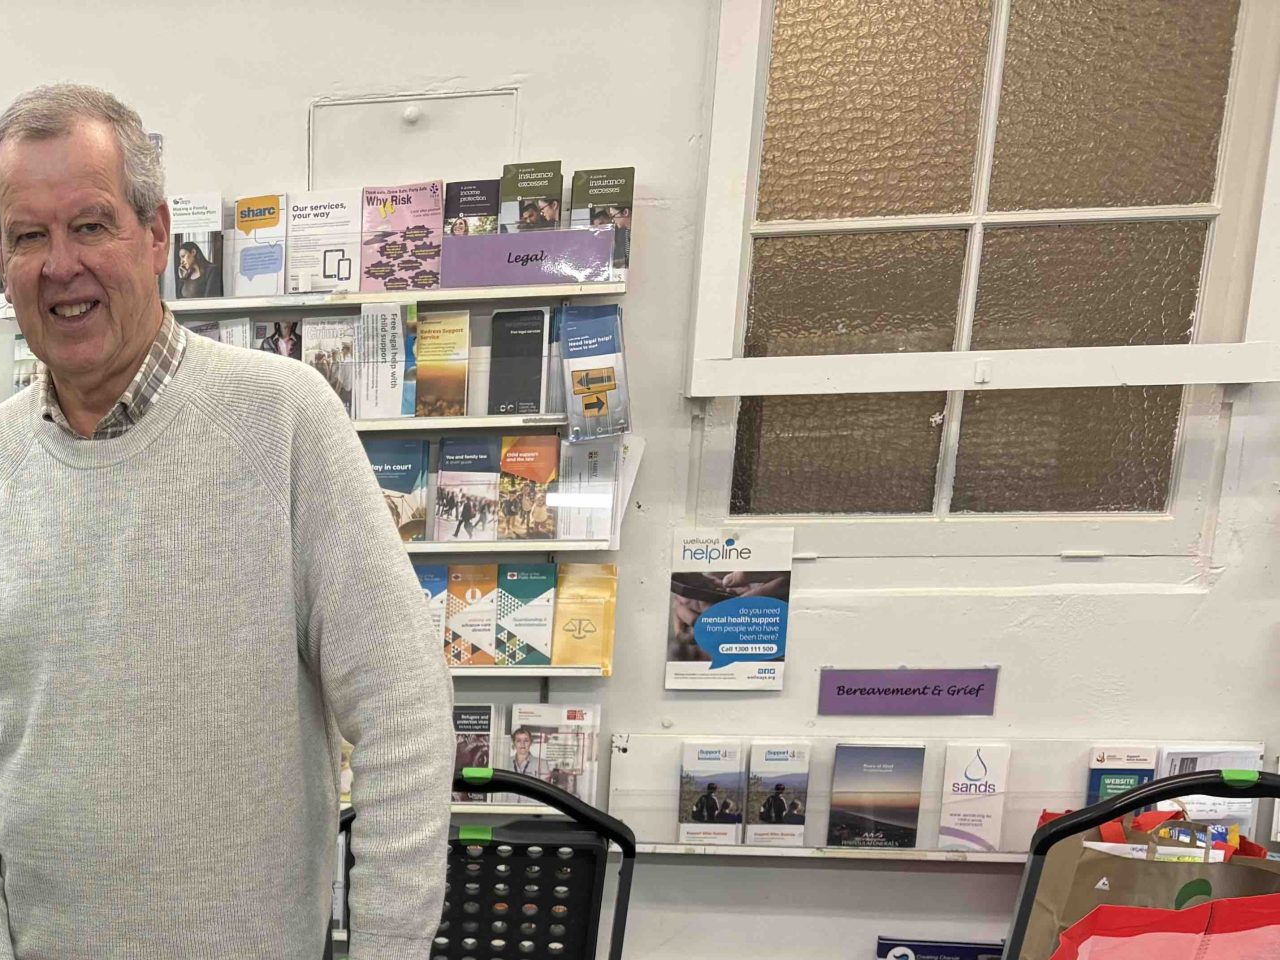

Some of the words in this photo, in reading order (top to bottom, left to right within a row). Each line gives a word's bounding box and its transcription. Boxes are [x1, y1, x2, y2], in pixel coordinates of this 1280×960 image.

[519, 172, 554, 180] insurance
[589, 178, 626, 187] insurance
[589, 187, 621, 195] excesses
[366, 194, 389, 208] Why
[391, 193, 412, 205] Risk
[240, 206, 277, 220] sharc
[292, 204, 310, 213] Our
[311, 201, 347, 212] services,
[292, 212, 310, 220] your
[312, 210, 331, 219] way
[506, 250, 548, 267] Legal
[380, 313, 388, 332] child
[390, 313, 399, 331] Free
[390, 332, 399, 355] legal
[583, 338, 597, 347] legal
[597, 335, 613, 343] help?
[380, 333, 388, 364] support
[389, 356, 399, 370] help
[390, 370, 398, 389] with
[683, 537, 720, 546] wellways
[683, 545, 752, 564] helpline
[749, 608, 762, 617] you
[762, 607, 781, 615] need
[701, 616, 727, 624] mental
[727, 616, 751, 624] health
[751, 616, 780, 625] support
[723, 625, 747, 633] people
[757, 633, 779, 641] there?
[720, 645, 733, 653] Call
[734, 645, 749, 653] 1300
[750, 645, 761, 653] 111
[762, 645, 774, 653] 500
[835, 684, 929, 698] Bereavement
[931, 685, 944, 697] &
[945, 684, 986, 699] Grief
[951, 780, 996, 794] sands
[1104, 778, 1136, 786] WEBSITE
